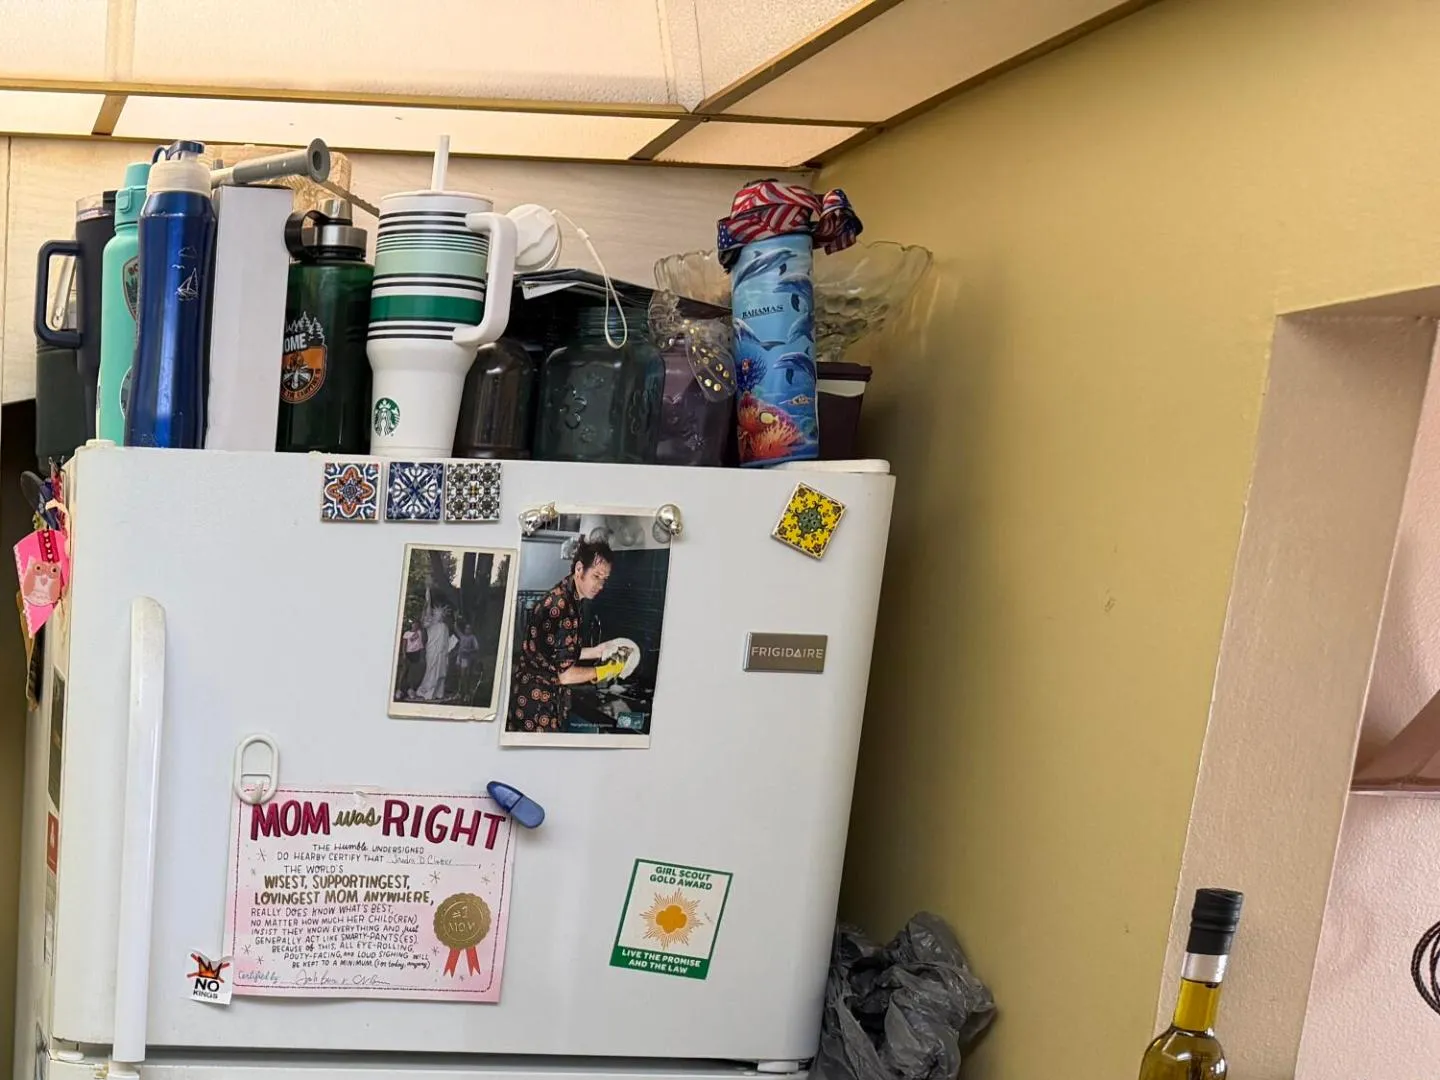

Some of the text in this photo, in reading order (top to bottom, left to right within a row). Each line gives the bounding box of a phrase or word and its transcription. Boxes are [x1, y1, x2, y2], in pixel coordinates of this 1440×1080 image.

[741, 304, 785, 320] BAHAMAS
[284, 332, 308, 353] OME
[751, 646, 824, 660] FRIGIDAIRE
[250, 799, 506, 850] MOM was RIGHT
[312, 843, 331, 852] THE
[371, 845, 425, 855] UNDERSIGNED
[277, 851, 384, 863] DO HEARBY CERTIFY THAT
[284, 864, 344, 874] THE WORLD'S
[655, 866, 712, 881] GIRL SCOUT
[264, 874, 411, 890] WISEST, SUPPORTINGEST,
[650, 874, 713, 890] GOLD AWARD
[254, 890, 434, 906] LOVINGEST MOM ANYWHERE,
[250, 907, 282, 917] REALLY
[285, 907, 310, 917] DOES
[312, 906, 335, 917] KNOW
[339, 903, 369, 915] WHAT'S
[250, 913, 418, 928] NO MATTER HOW MUCH HER CHILD(REN)
[251, 927, 277, 936] INSIST
[282, 927, 304, 936] THEY
[306, 926, 330, 935] KNOW
[332, 924, 380, 934] EVERYTHING
[382, 924, 400, 933] AND
[255, 936, 301, 946] GENERALLY
[305, 935, 320, 944] ACT
[323, 934, 339, 943] LIKE
[271, 945, 302, 954] BECAUSE
[339, 941, 355, 950] ALL
[357, 951, 377, 959] LOUD
[621, 948, 702, 968] LIVE THE PROMISE
[291, 961, 300, 969] BE
[302, 960, 319, 968] KEPT
[321, 959, 330, 967] TO
[628, 958, 688, 974] AND THE LAW
[194, 977, 220, 993] NO
[192, 989, 219, 999] KINGS
